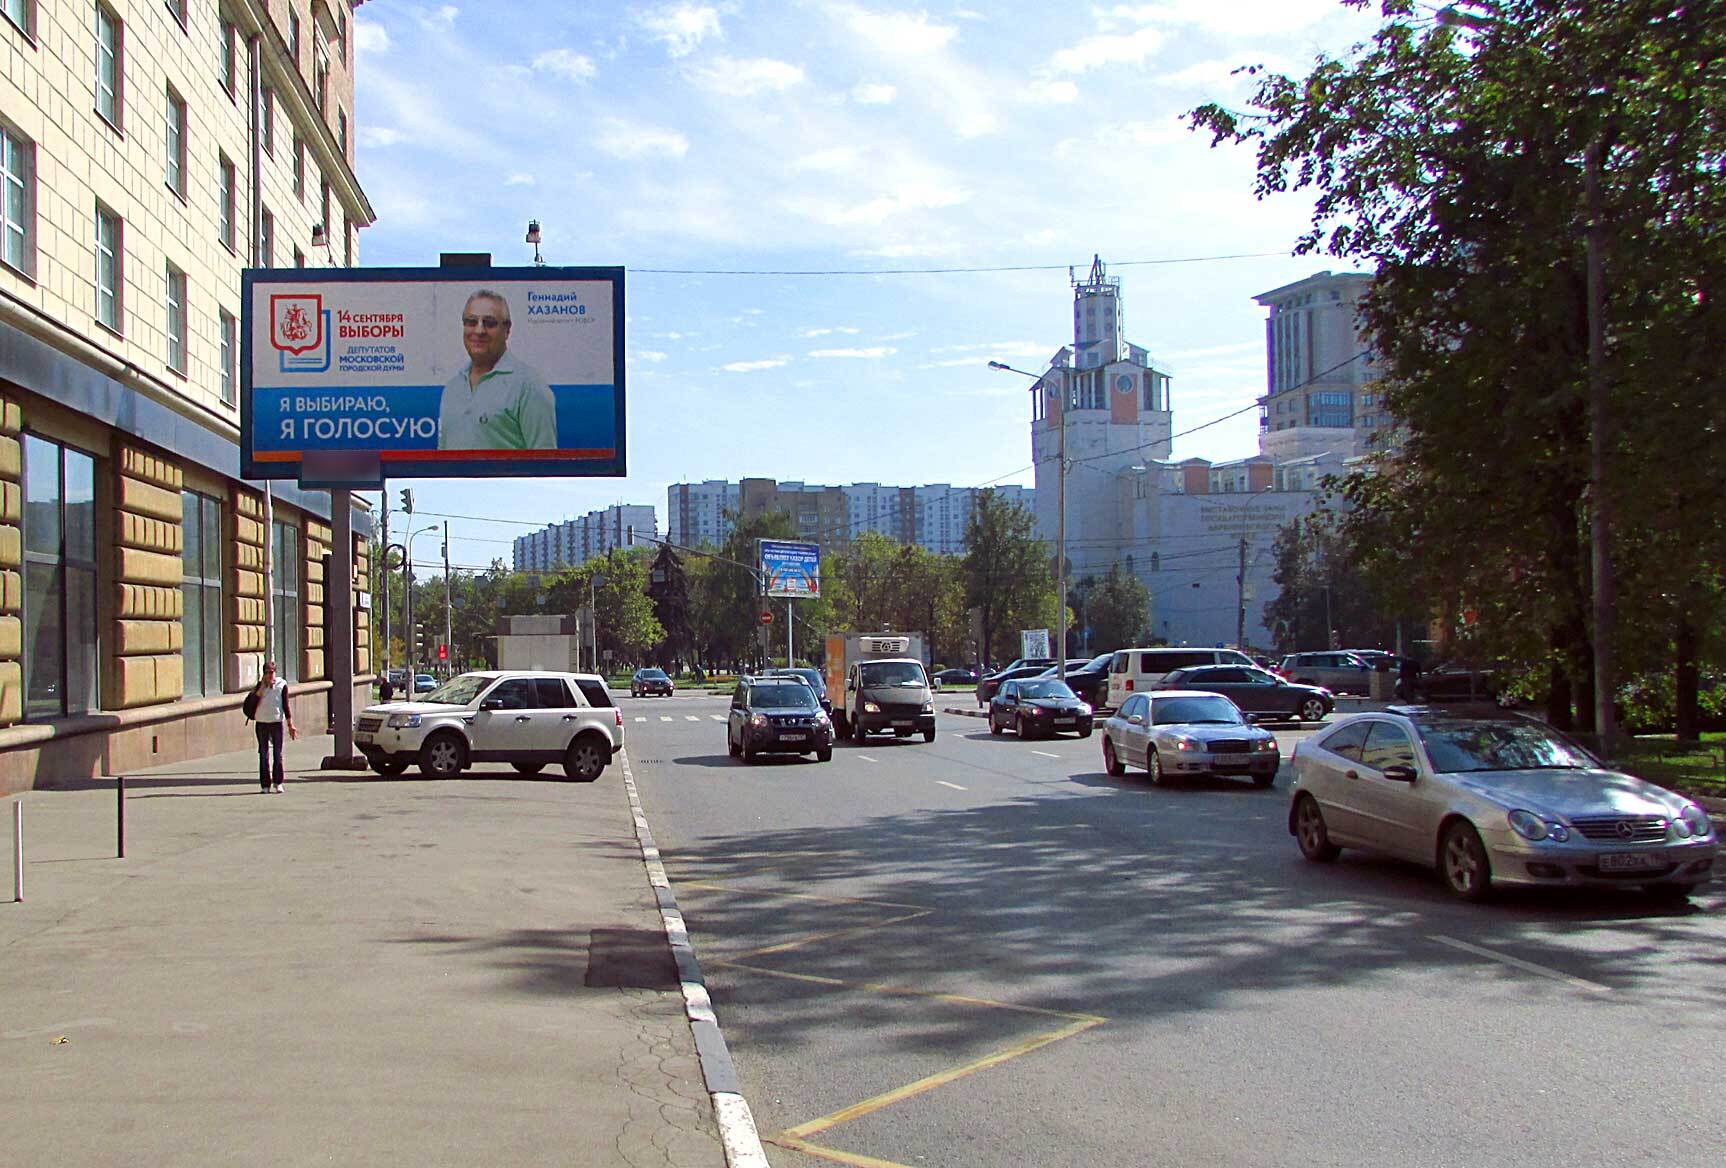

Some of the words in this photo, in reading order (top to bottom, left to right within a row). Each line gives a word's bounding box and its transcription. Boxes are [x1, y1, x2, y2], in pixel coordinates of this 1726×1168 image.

[528, 291, 577, 302] Геннадий
[528, 305, 586, 315] ХАЗАНОВ
[337, 310, 351, 323] 14
[353, 313, 404, 323] СЕНТЯБРЯ
[339, 325, 404, 338] ВЫБОРЫ
[347, 345, 396, 354] ДЕПУТАТОВ
[339, 353, 405, 364] МОСКОВСКОЙ
[339, 364, 382, 372] ГОРОДСКОЙ
[383, 364, 405, 372] ДУМЫ
[280, 397, 290, 412] Я
[295, 396, 391, 414] ВЫБИРАЮ,
[280, 418, 295, 439] Я
